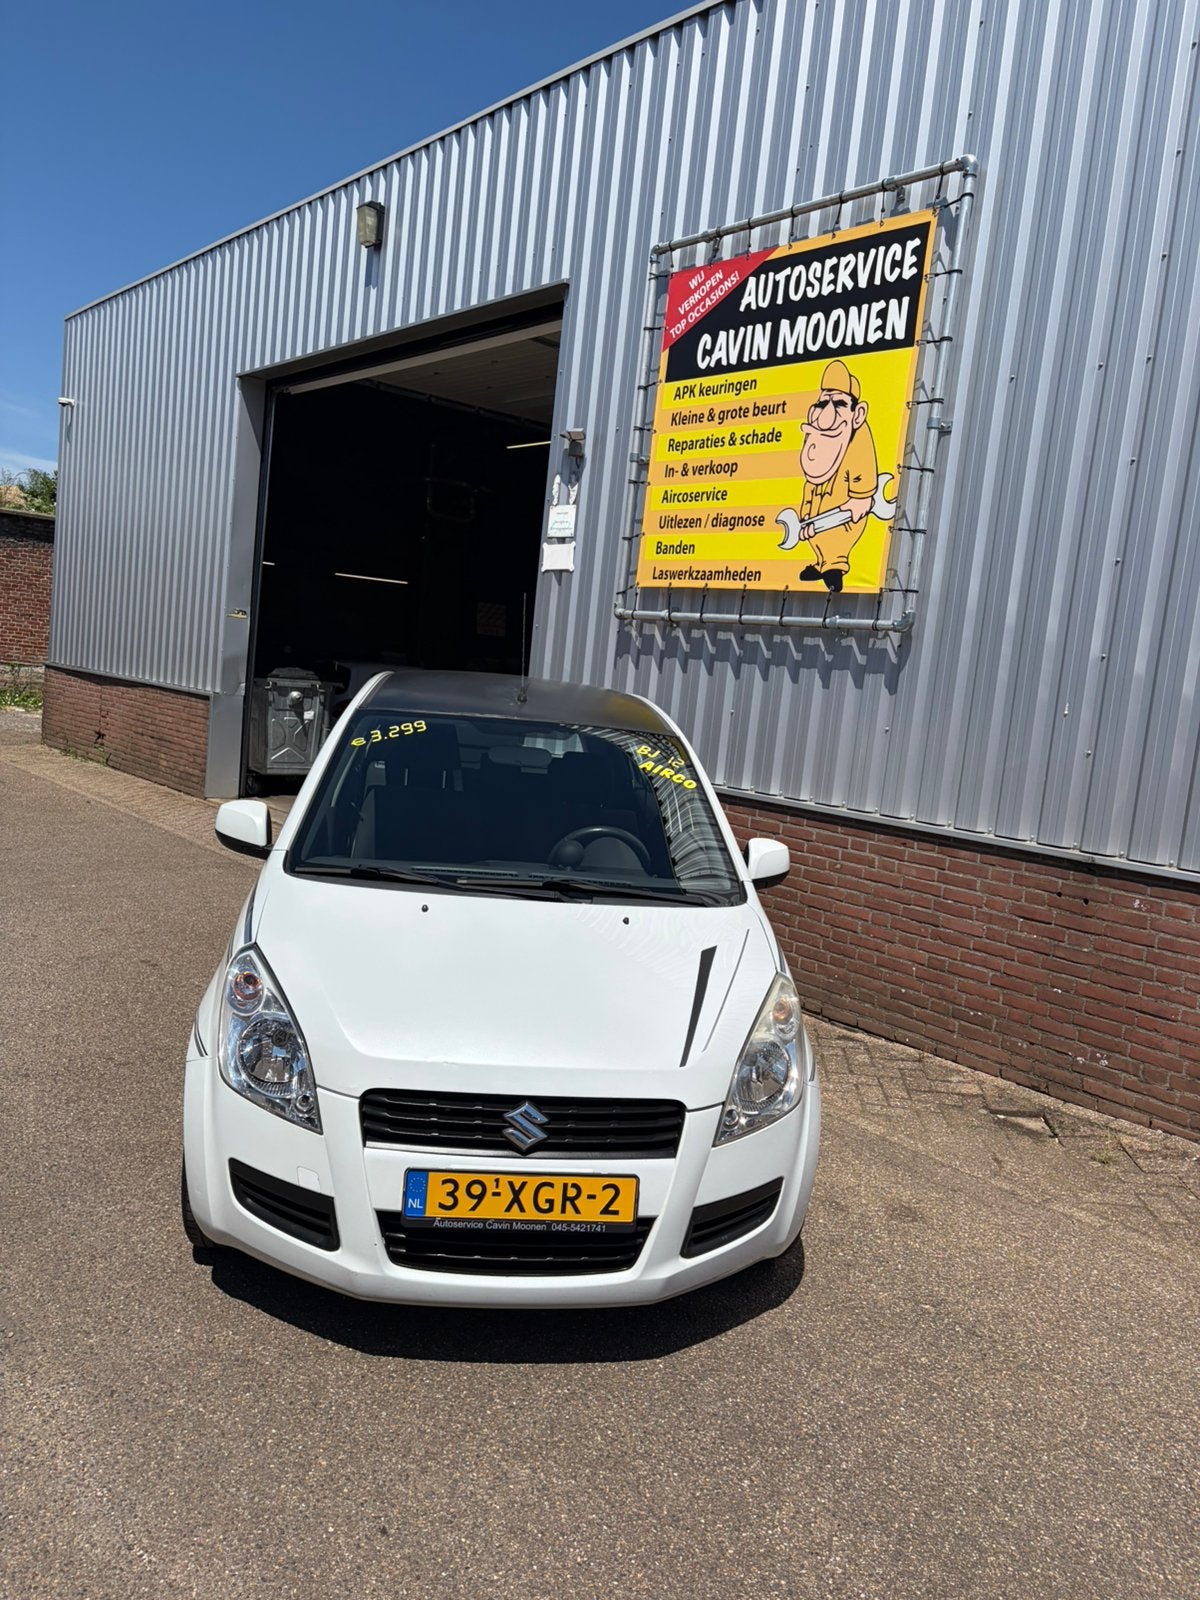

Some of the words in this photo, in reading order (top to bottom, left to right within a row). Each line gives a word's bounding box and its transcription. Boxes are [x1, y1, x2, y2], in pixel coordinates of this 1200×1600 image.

[688, 270, 705, 289] WIJ
[739, 237, 921, 312] AUTOSERVICE
[678, 270, 723, 315] VERKOPEN
[670, 318, 687, 338] TOP
[688, 270, 740, 323] OCCASIONS!
[697, 321, 772, 370] CAVIN
[776, 296, 910, 358] MOONEN
[673, 383, 697, 401] APK
[698, 379, 757, 397] keuringen
[670, 410, 705, 427] Kleine
[707, 408, 716, 422] &
[718, 405, 750, 425] grote
[752, 400, 787, 417] beurt
[667, 434, 726, 454] Reparaties
[728, 432, 737, 446] &
[739, 427, 782, 446] schade
[664, 464, 679, 478] In-
[681, 462, 690, 477] &
[692, 460, 738, 477] verkoop
[661, 486, 728, 504] Aircoservice
[659, 514, 702, 529] Uitlezen
[704, 513, 710, 528] /
[711, 513, 765, 531] diagnose
[656, 540, 695, 555] Banden
[652, 565, 761, 581] Laswerkzaamheden
[370, 720, 427, 743] 3.299
[637, 745, 661, 758] BJ
[639, 760, 697, 789] AIRCO
[407, 1198, 423, 1209] NL
[433, 1218, 484, 1230] Autoservice
[486, 1219, 510, 1231] Cavin
[512, 1221, 547, 1231] Moonen
[551, 1223, 606, 1233] 045-5421741
